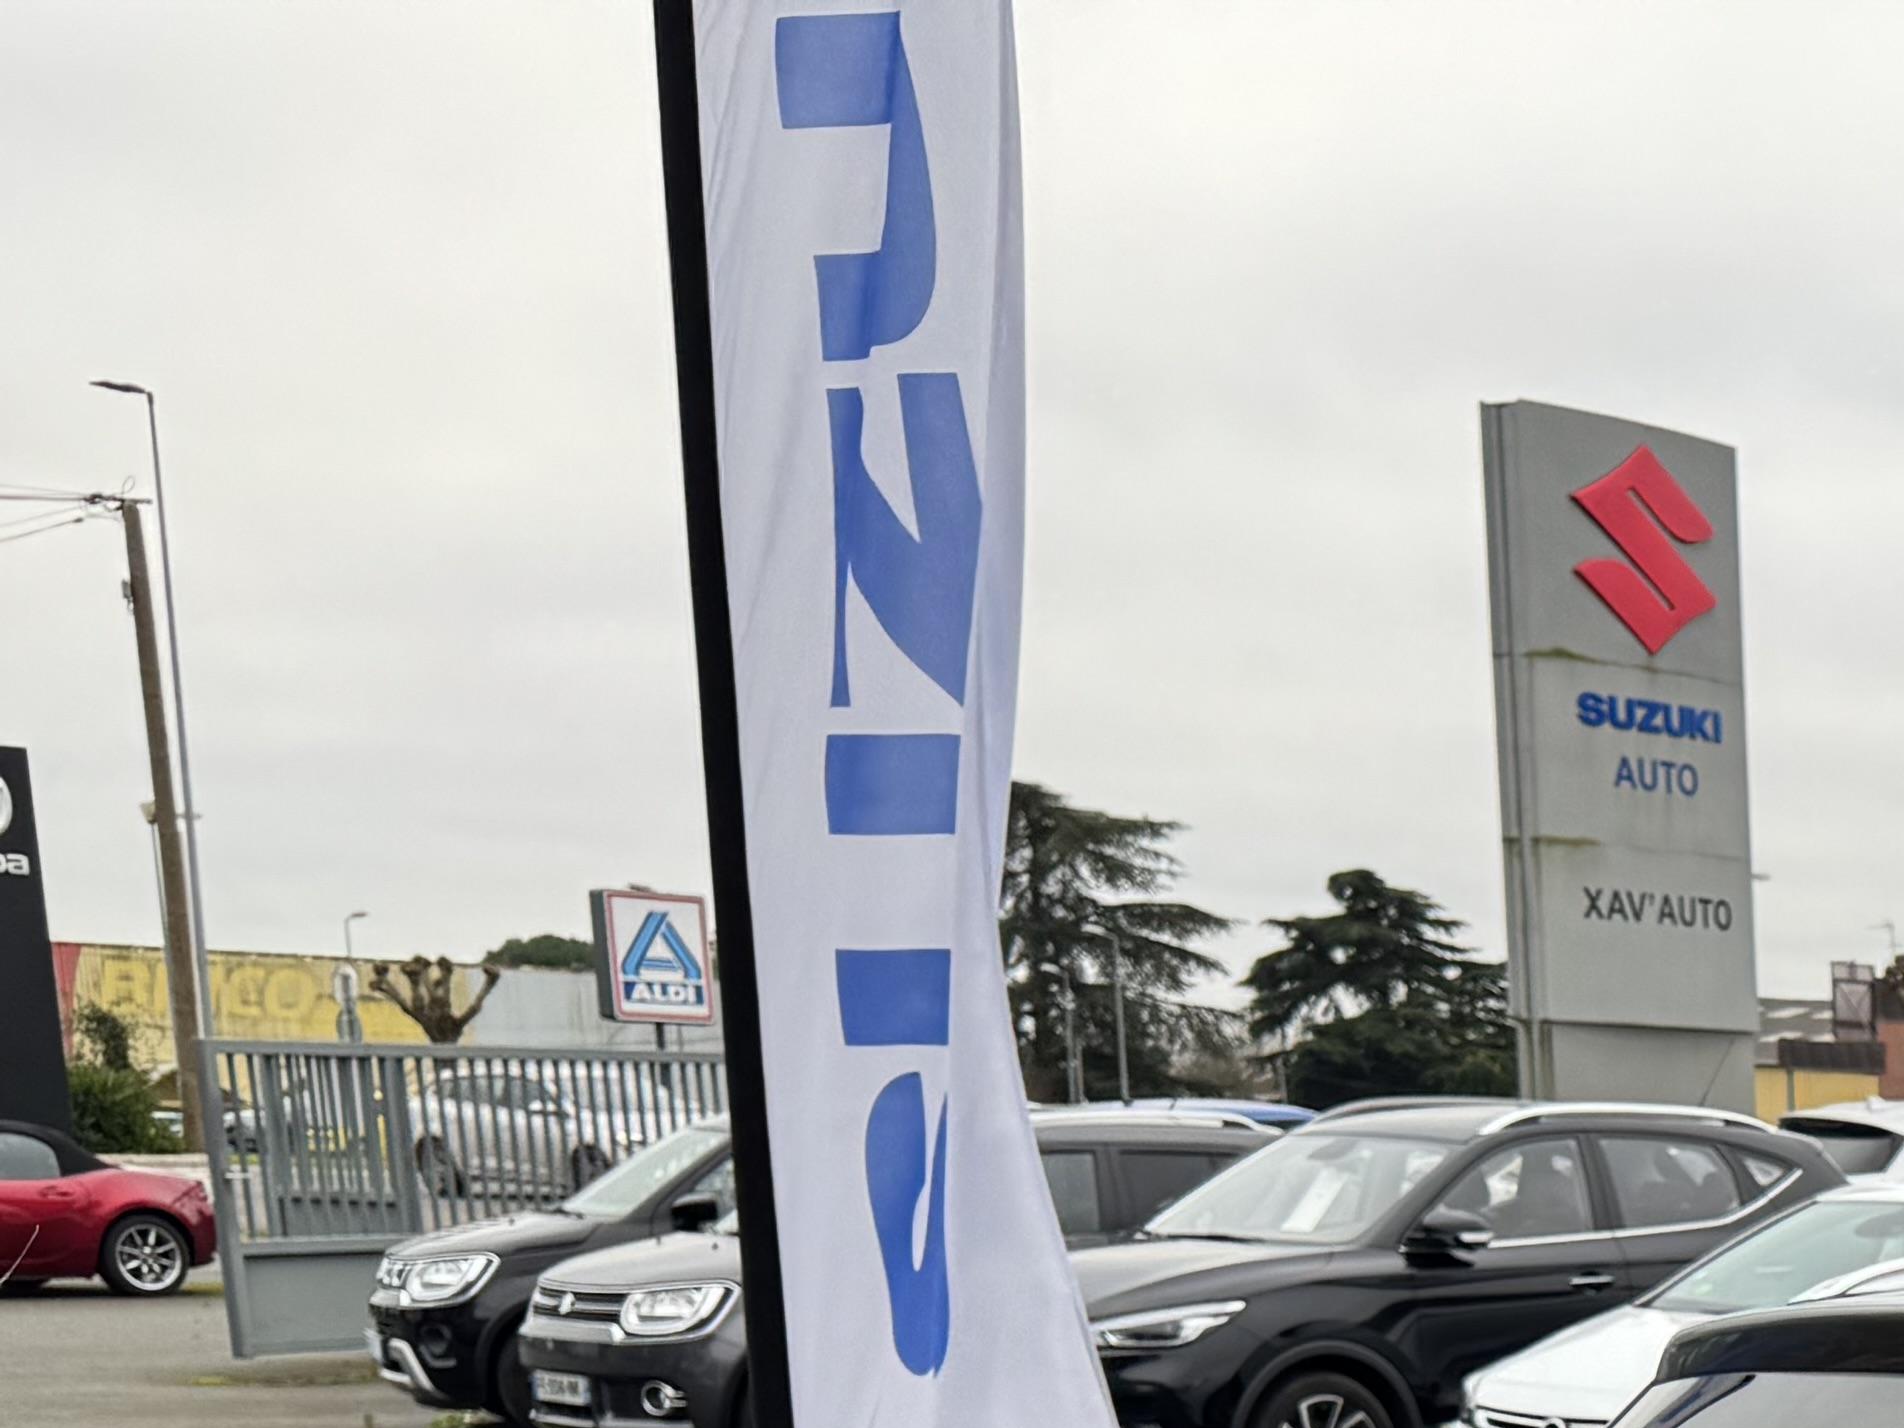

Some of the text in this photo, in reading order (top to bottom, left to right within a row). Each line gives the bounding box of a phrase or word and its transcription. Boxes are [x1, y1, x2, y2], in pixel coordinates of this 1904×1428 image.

[1576, 691, 1723, 744] SUZUKI
[1614, 755, 1699, 797] AUTO
[1582, 886, 1733, 932] XAV'AUTO
[630, 981, 698, 1002] ALDI
